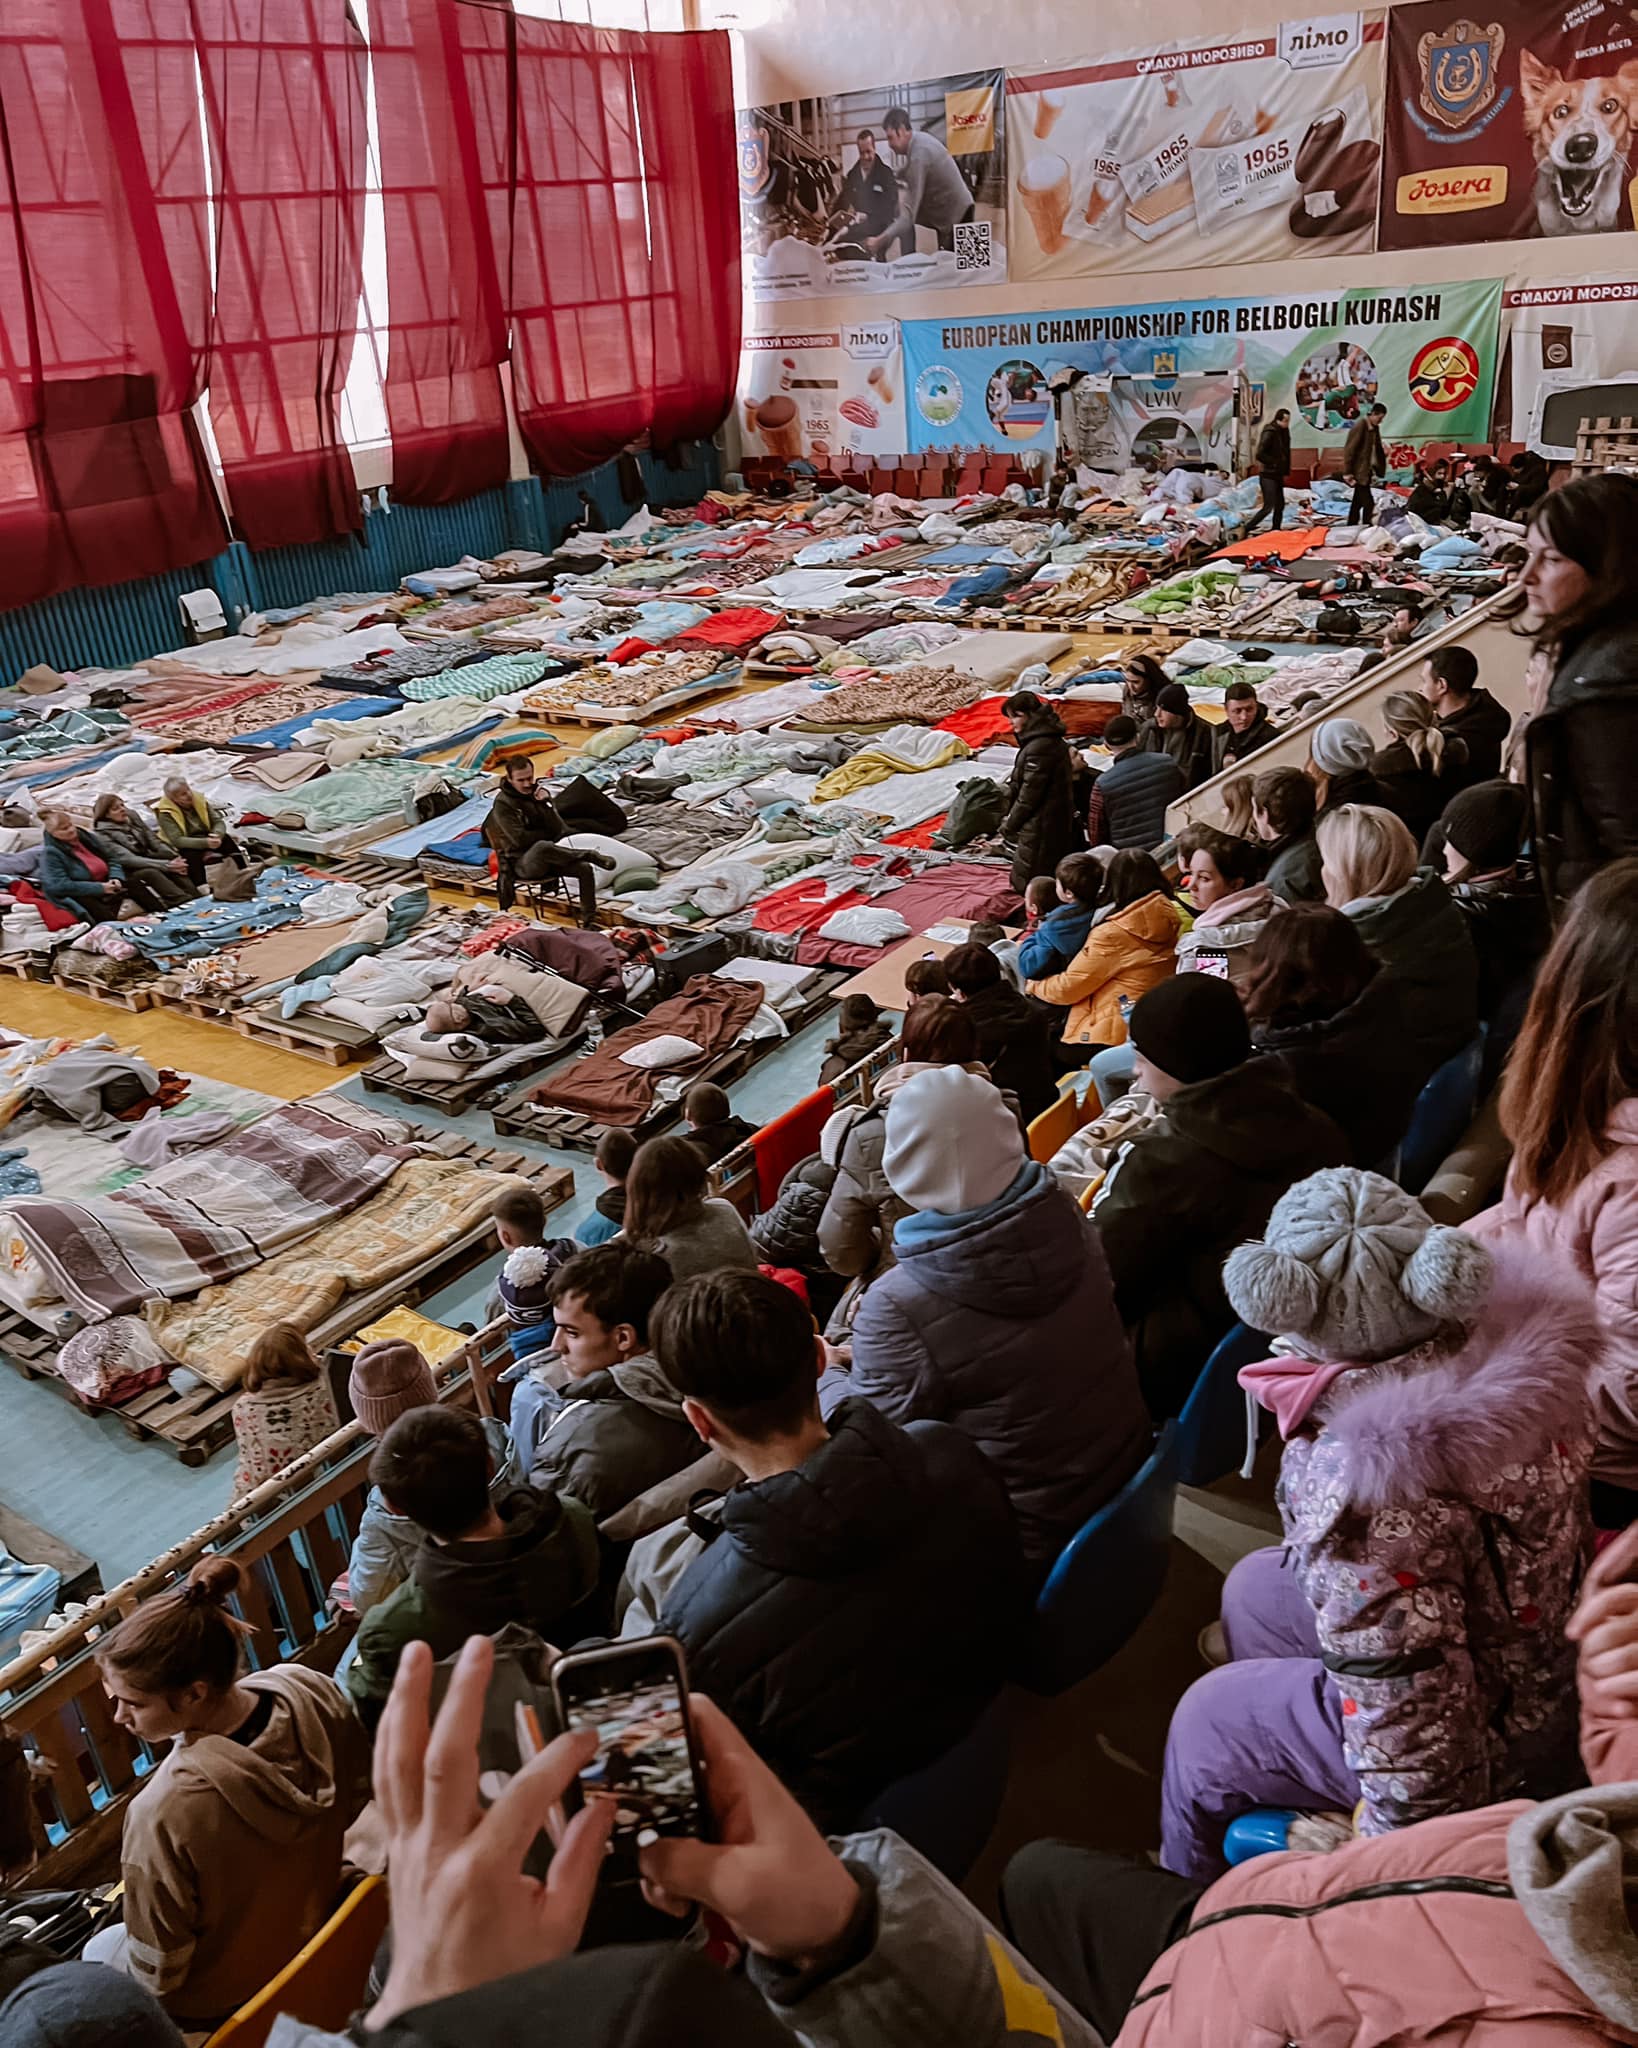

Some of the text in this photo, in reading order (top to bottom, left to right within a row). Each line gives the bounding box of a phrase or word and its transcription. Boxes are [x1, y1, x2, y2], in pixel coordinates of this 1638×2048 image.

[1289, 26, 1349, 51] лімо
[1136, 43, 1265, 73] СМАКУЙ МОРОЗИВО
[1155, 134, 1188, 168] 1965
[1244, 139, 1289, 170] 1965
[1093, 158, 1121, 176] 1965
[1245, 160, 1293, 184] ПЛОМБІР
[1408, 177, 1492, 201] Josera
[1510, 287, 1573, 305] СМАКУЙ
[942, 294, 1441, 350] EUROPEAN CHAMPIONSHIP FOR BELBOGLI KURASH
[850, 328, 888, 345] лімо
[1145, 391, 1182, 408] LVIV
[806, 419, 829, 430] 1965
